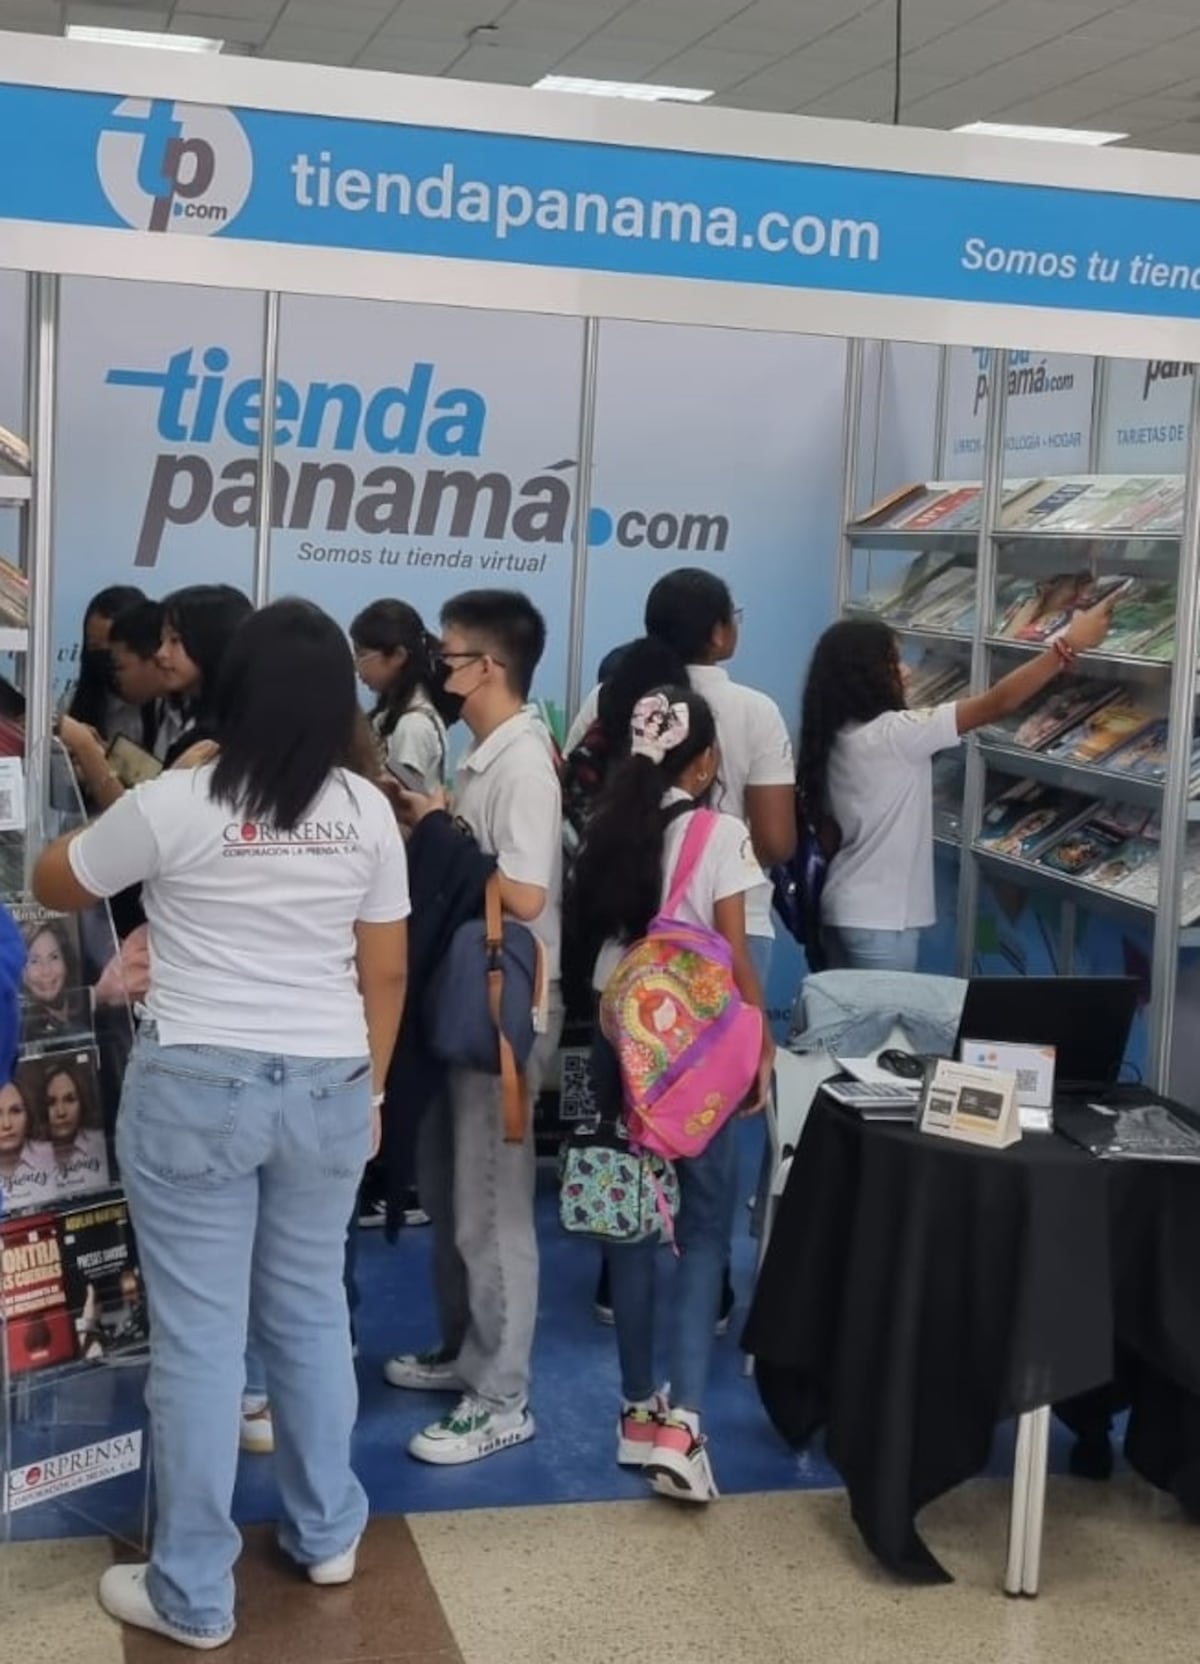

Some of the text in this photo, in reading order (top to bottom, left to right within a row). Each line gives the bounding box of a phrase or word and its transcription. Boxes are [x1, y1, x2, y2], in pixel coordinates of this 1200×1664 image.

[290, 150, 881, 263] tiendapanama.com
[961, 237, 1078, 279] Somos
[1087, 250, 1120, 283] tu
[105, 346, 487, 457] tienda
[297, 541, 547, 573] Somos tu tienda virtual
[9, 1436, 135, 1491] CORPRENSA
